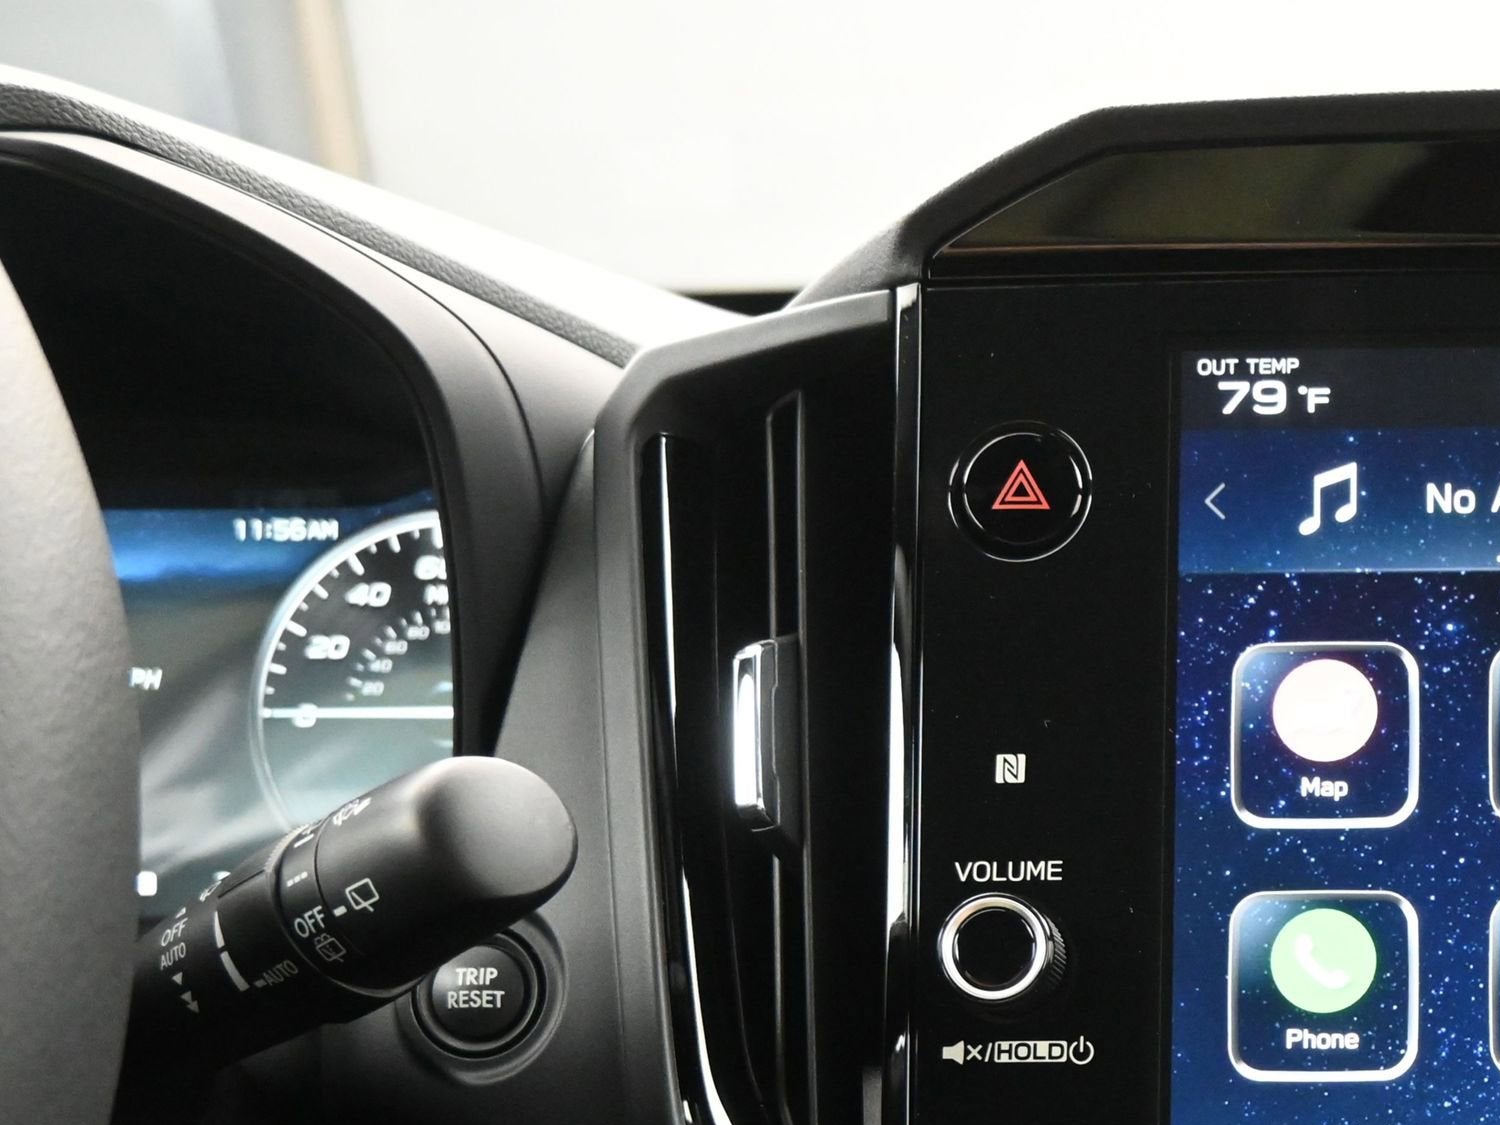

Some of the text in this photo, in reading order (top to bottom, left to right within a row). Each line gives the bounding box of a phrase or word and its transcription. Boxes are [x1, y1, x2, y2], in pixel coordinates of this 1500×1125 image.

[1196, 358, 1300, 376] OUT TEMP
[1217, 380, 1287, 415] 79
[1426, 482, 1476, 515] No
[345, 582, 391, 608] 40
[305, 634, 350, 660] 20
[1299, 775, 1349, 800] Map
[954, 860, 1063, 882] VOLUME
[161, 917, 188, 947] OFF
[294, 905, 325, 938] OFF
[160, 942, 187, 971] AUTO
[264, 959, 299, 986] AUTO
[456, 968, 498, 986] TRIP
[447, 991, 505, 1009] RESET
[996, 1041, 1065, 1061] HOLD
[1285, 1028, 1360, 1051] Phone
